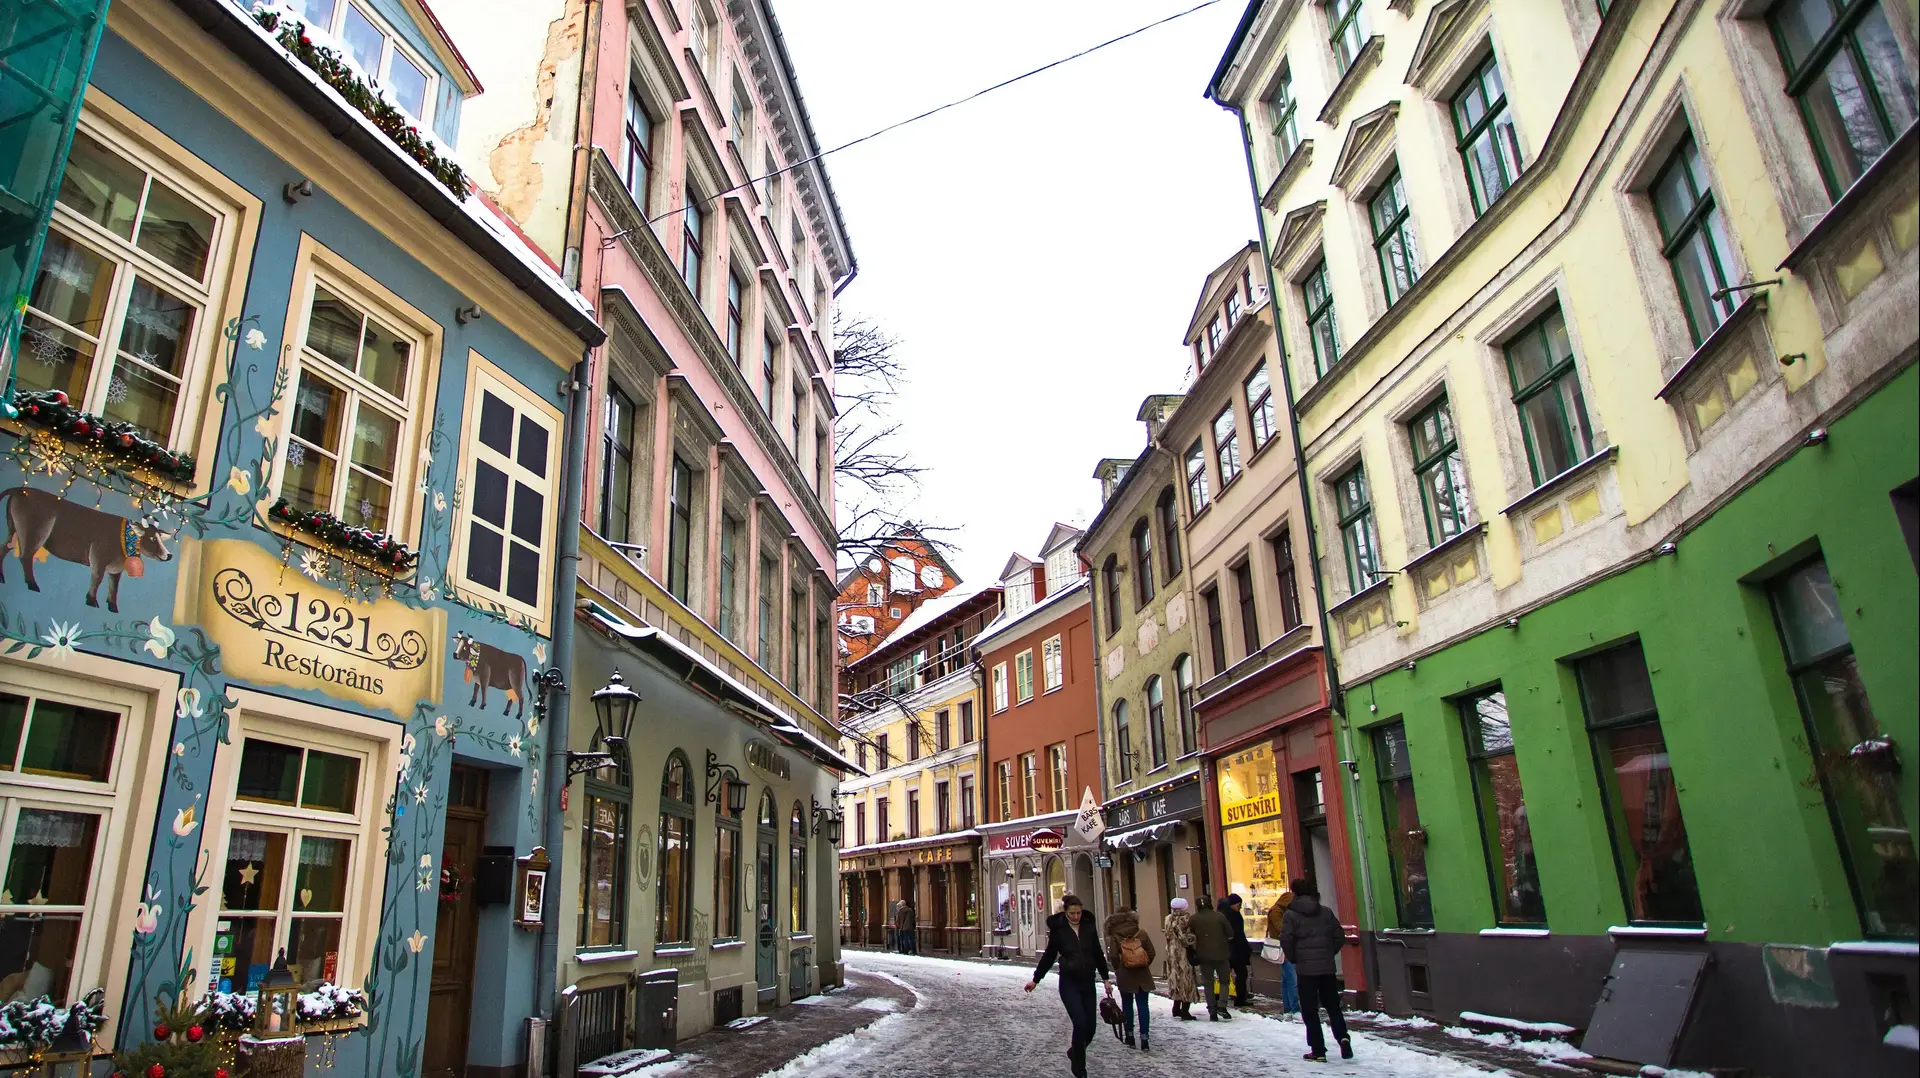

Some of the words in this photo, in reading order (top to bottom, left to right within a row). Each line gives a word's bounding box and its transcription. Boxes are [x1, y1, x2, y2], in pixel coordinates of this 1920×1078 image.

[281, 592, 373, 655] 1221
[262, 639, 384, 695] Restorāns
[1081, 806, 1098, 822] BĀRS
[1227, 797, 1277, 822] SUVENĪRI
[1005, 833, 1033, 848] SUVEN
[918, 848, 953, 863] CAFE
